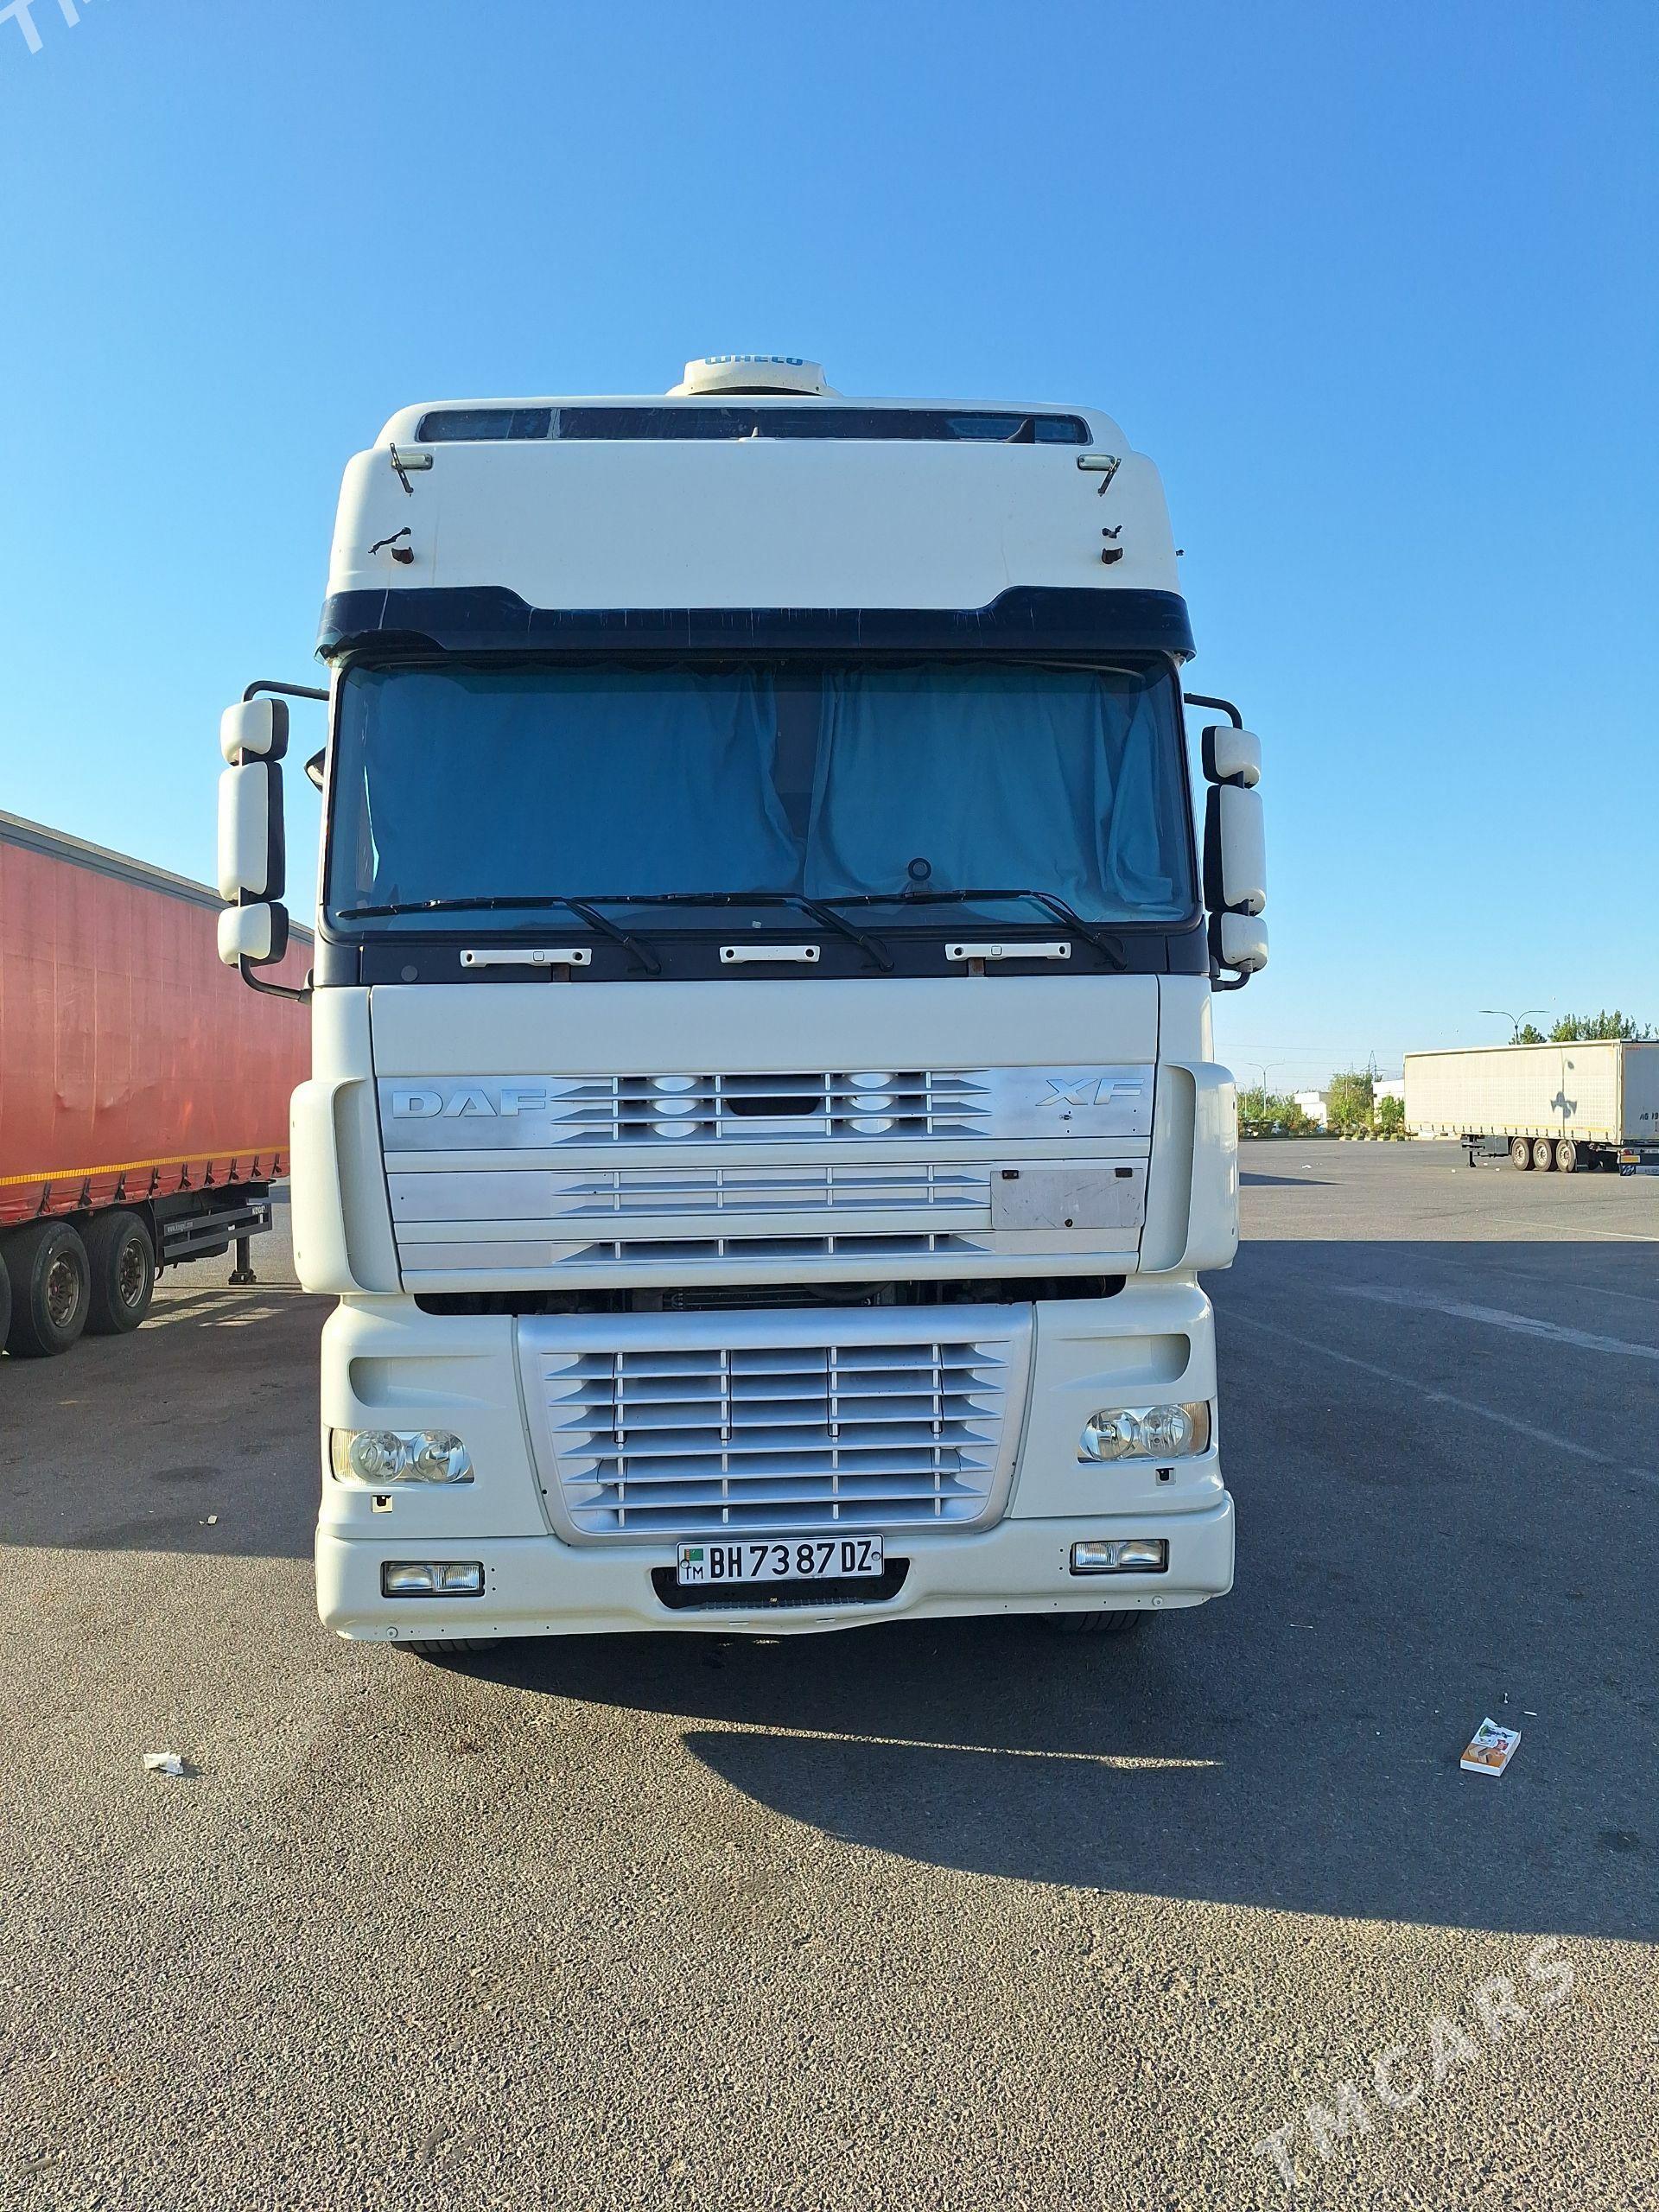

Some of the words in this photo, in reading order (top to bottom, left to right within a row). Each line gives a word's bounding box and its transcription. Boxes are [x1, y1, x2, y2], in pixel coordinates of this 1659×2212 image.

[392, 1089, 547, 1119] DAF
[1035, 1077, 1146, 1107] XF
[684, 1566, 703, 1580] TM
[709, 1546, 742, 1579] BH
[749, 1542, 836, 1577] 7387
[841, 1540, 873, 1573] DZ
